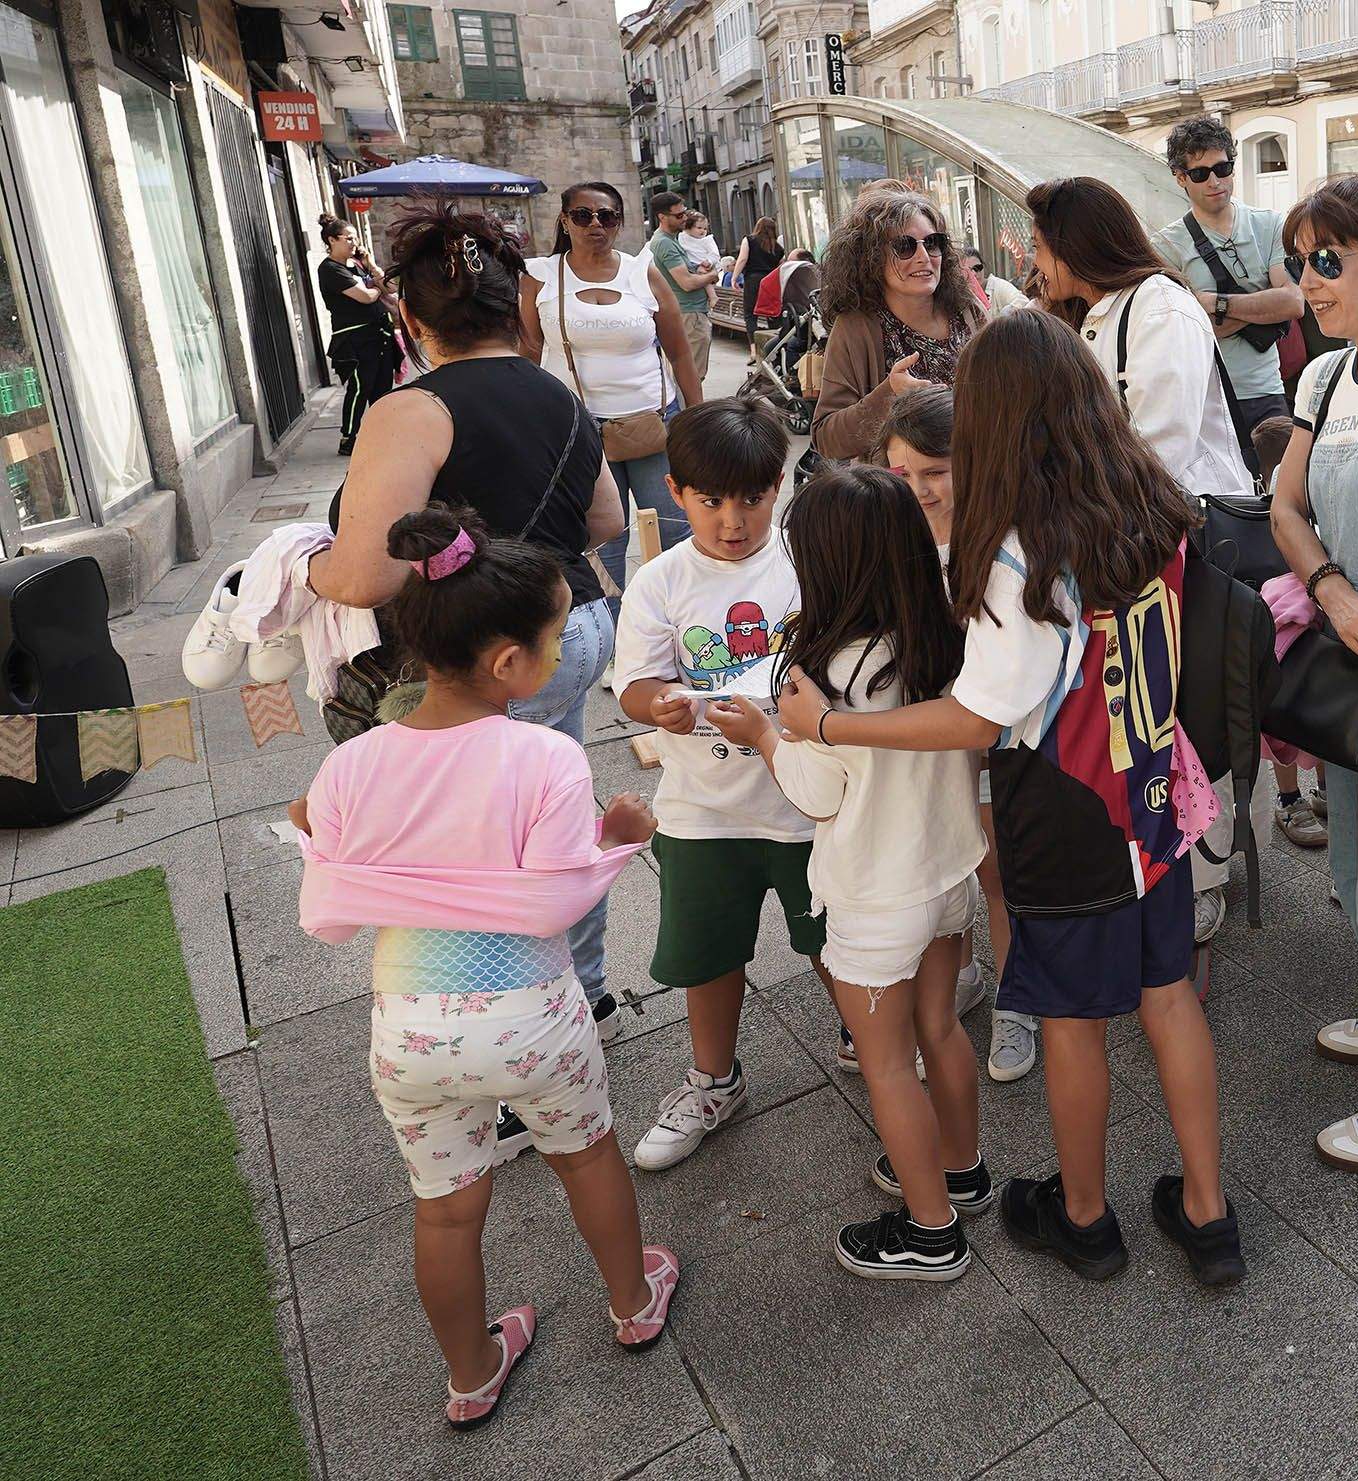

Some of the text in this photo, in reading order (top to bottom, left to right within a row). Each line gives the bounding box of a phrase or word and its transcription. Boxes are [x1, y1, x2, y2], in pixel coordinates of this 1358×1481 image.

[263, 102, 316, 115] VENDING
[273, 115, 310, 131] 24 H
